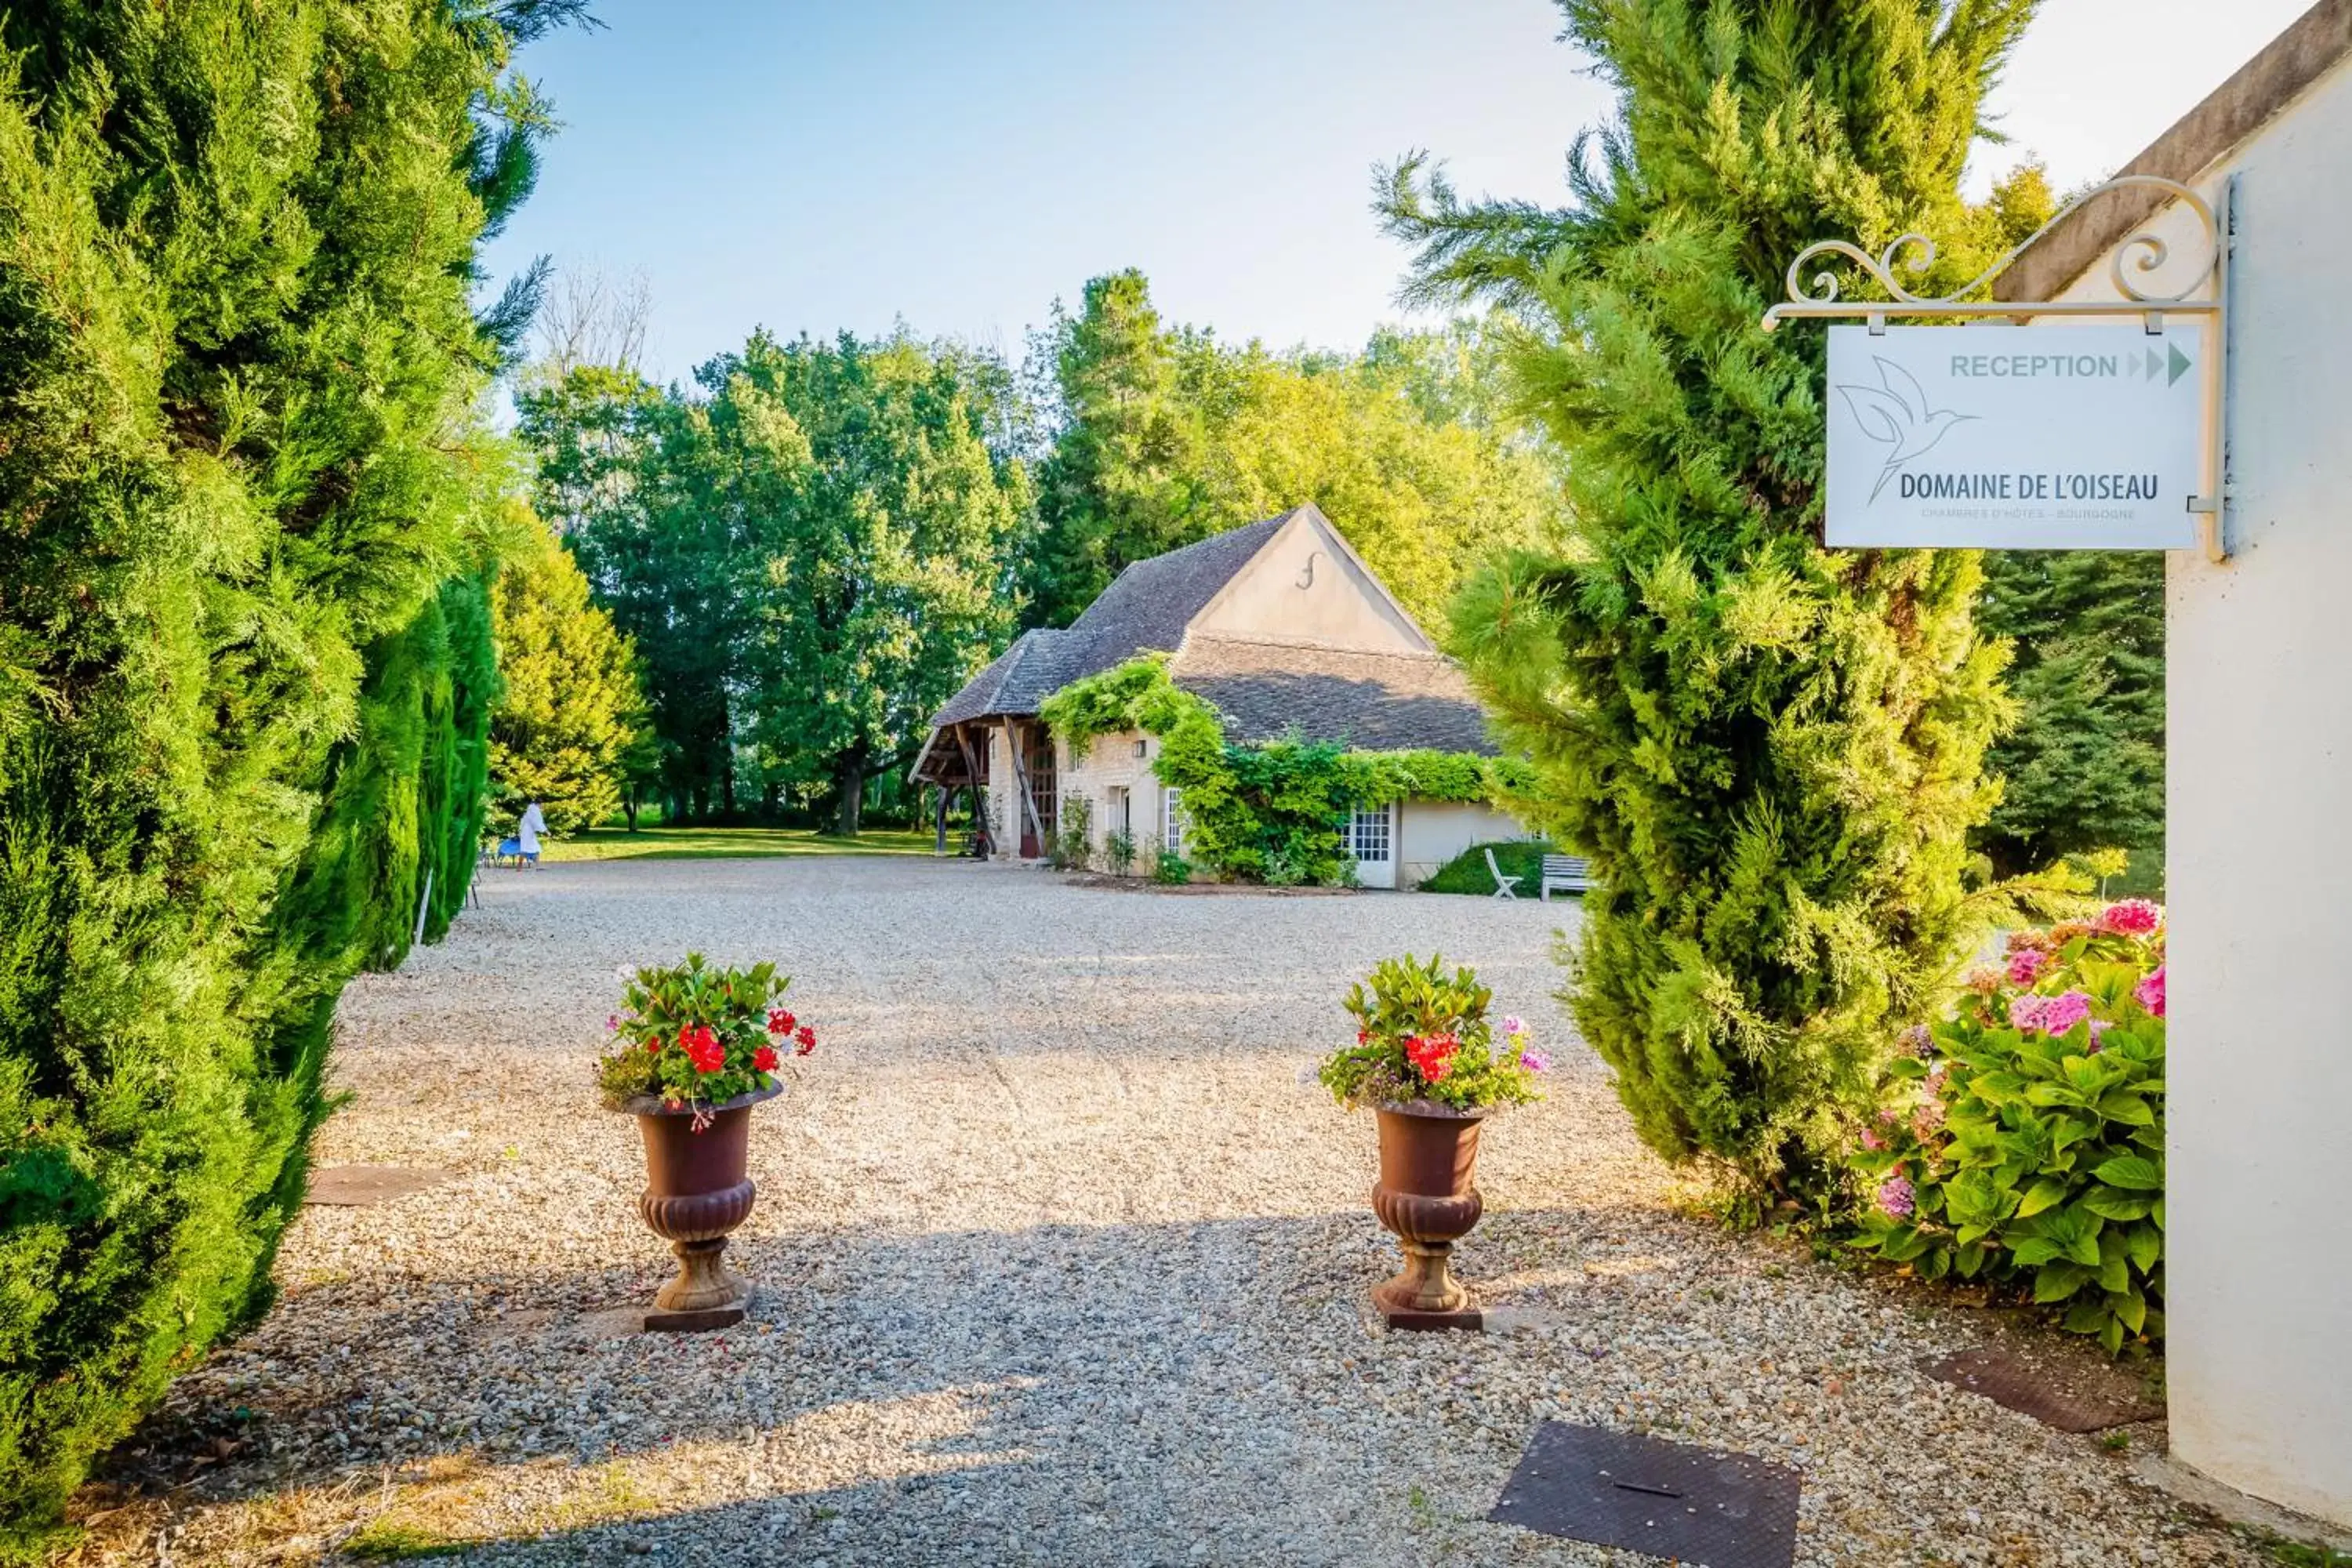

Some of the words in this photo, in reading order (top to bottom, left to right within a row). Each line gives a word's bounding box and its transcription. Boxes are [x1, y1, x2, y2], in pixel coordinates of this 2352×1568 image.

[1951, 354, 2118, 377] RECEPTION
[1900, 473, 2012, 500] DOMAINE
[2019, 474, 2049, 499] DE
[2055, 474, 2158, 500] L'OISEAU
